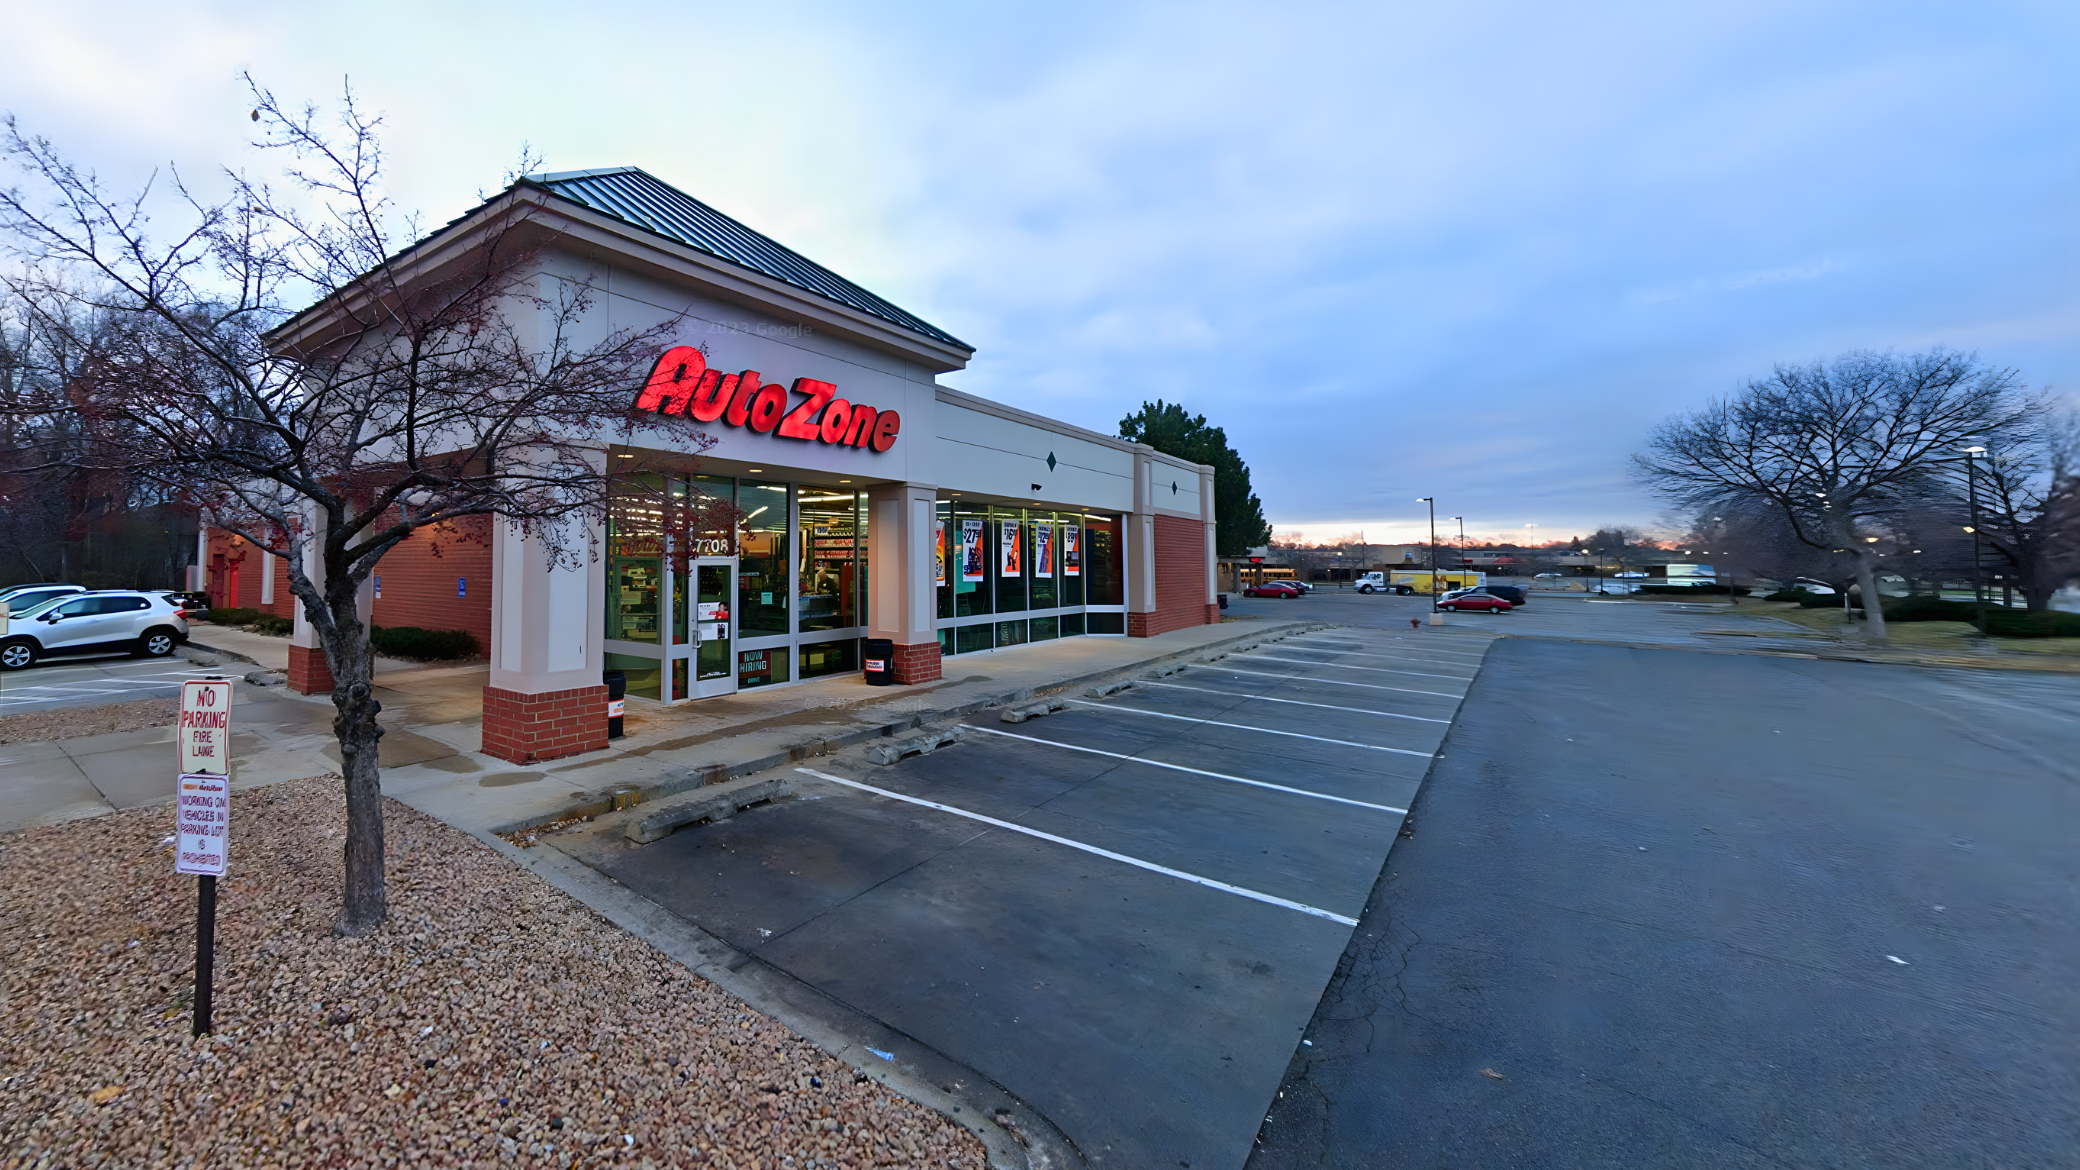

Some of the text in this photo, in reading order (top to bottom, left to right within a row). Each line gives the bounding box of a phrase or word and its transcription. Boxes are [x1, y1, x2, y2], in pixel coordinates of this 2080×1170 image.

[634, 344, 901, 452] AutoZone
[744, 650, 763, 662] NOW
[739, 660, 767, 673] HIRING
[196, 689, 217, 707] NO
[182, 710, 226, 729] PARKING
[193, 730, 213, 743] FIRE
